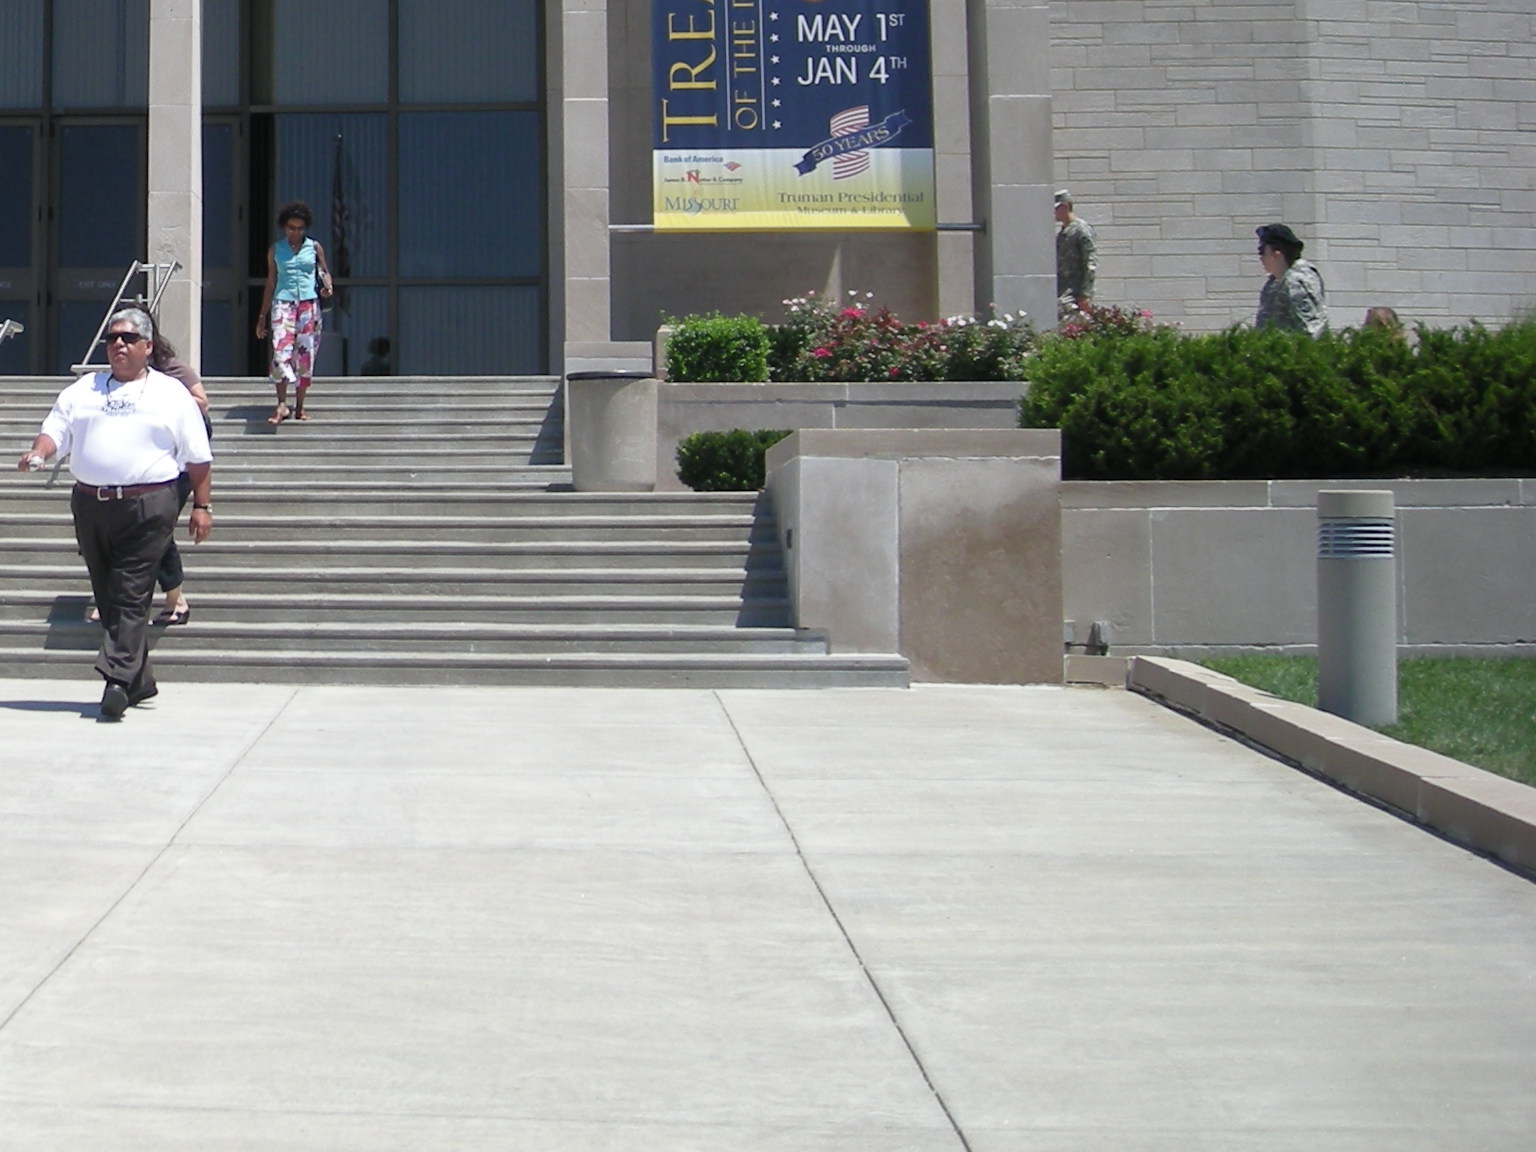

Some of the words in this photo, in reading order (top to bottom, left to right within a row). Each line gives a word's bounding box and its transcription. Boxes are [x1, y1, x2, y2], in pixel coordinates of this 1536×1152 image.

[797, 13, 862, 42] MAY
[732, 19, 757, 79] THE
[825, 44, 877, 53] THROUGH
[797, 56, 858, 85] JAN
[734, 89, 758, 130] OF
[812, 143, 833, 161] 50
[834, 125, 891, 152] YEARS
[693, 155, 724, 163] America
[778, 191, 833, 203] Truman
[838, 191, 924, 203] Presidential
